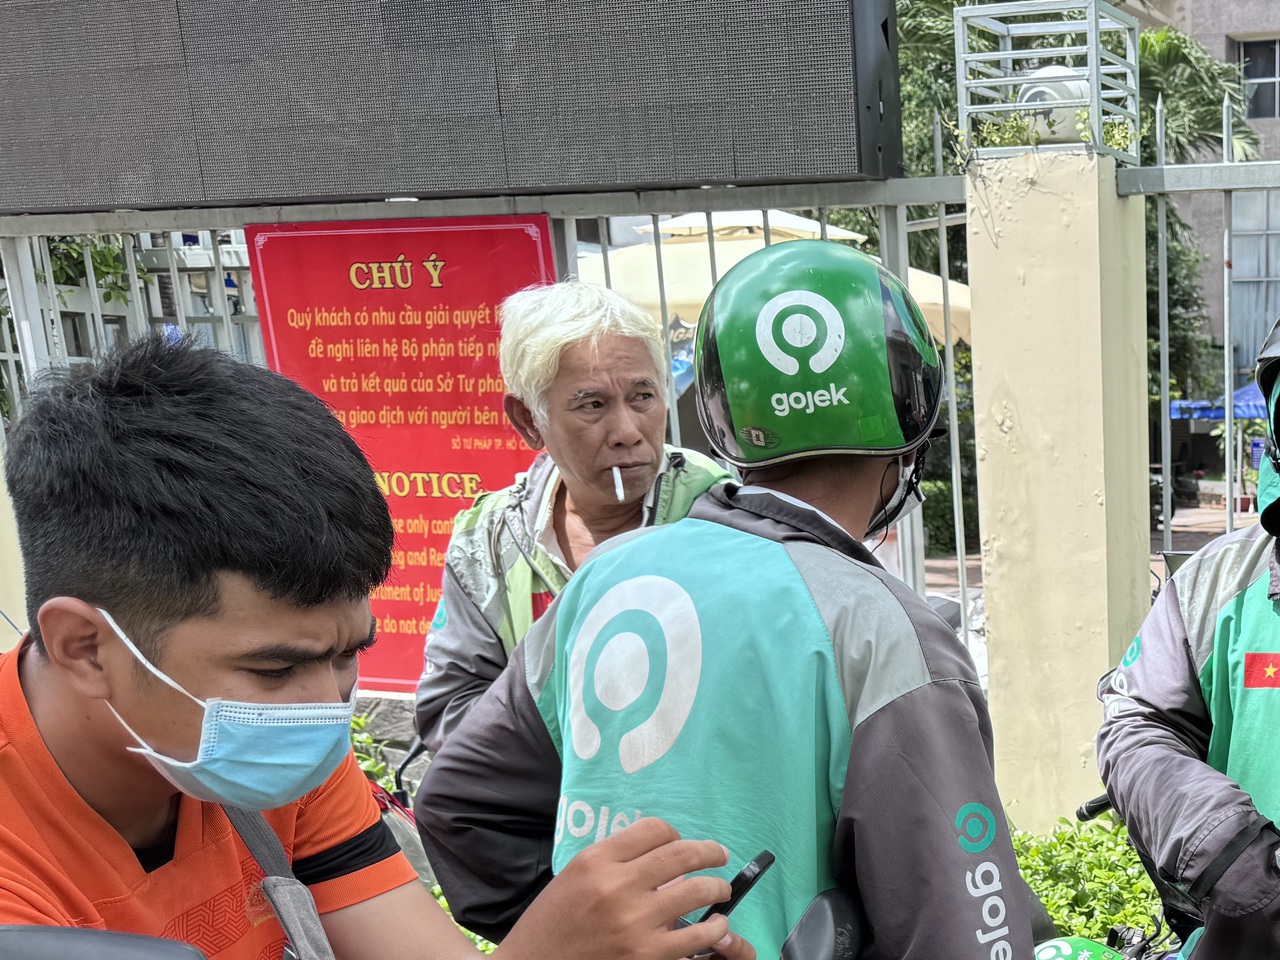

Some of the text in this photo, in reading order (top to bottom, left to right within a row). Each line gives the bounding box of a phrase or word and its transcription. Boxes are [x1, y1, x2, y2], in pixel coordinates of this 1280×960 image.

[349, 252, 445, 290] CHÚ Ý
[287, 308, 312, 330] Quý
[315, 307, 351, 327] khách
[355, 307, 369, 326] có
[372, 307, 395, 326] nhu
[399, 304, 422, 326] cầu
[425, 305, 449, 329] giải
[453, 303, 491, 329] quyết
[308, 338, 323, 358] đề
[327, 339, 354, 362] nghị
[357, 338, 380, 358] liên
[383, 338, 398, 360] hệ
[402, 339, 418, 360] Bộ
[421, 338, 455, 362] phận
[458, 335, 484, 361] tiếp
[322, 375, 337, 393] và
[340, 374, 358, 392] trả
[362, 371, 381, 392] kết
[384, 373, 407, 398] quả
[410, 373, 433, 393] của
[436, 372, 454, 392] Sở
[457, 374, 475, 393] Tư
[771, 383, 850, 417] gojek
[349, 407, 376, 428] giao
[379, 405, 404, 428] dịch
[408, 404, 428, 425] với
[432, 406, 471, 429] người
[474, 406, 498, 425] bên
[374, 471, 483, 498] NOTICE
[406, 513, 429, 539] only
[431, 517, 455, 535] cont
[407, 546, 427, 566] and
[413, 582, 424, 606] of
[384, 613, 397, 633] do
[400, 616, 417, 634] not
